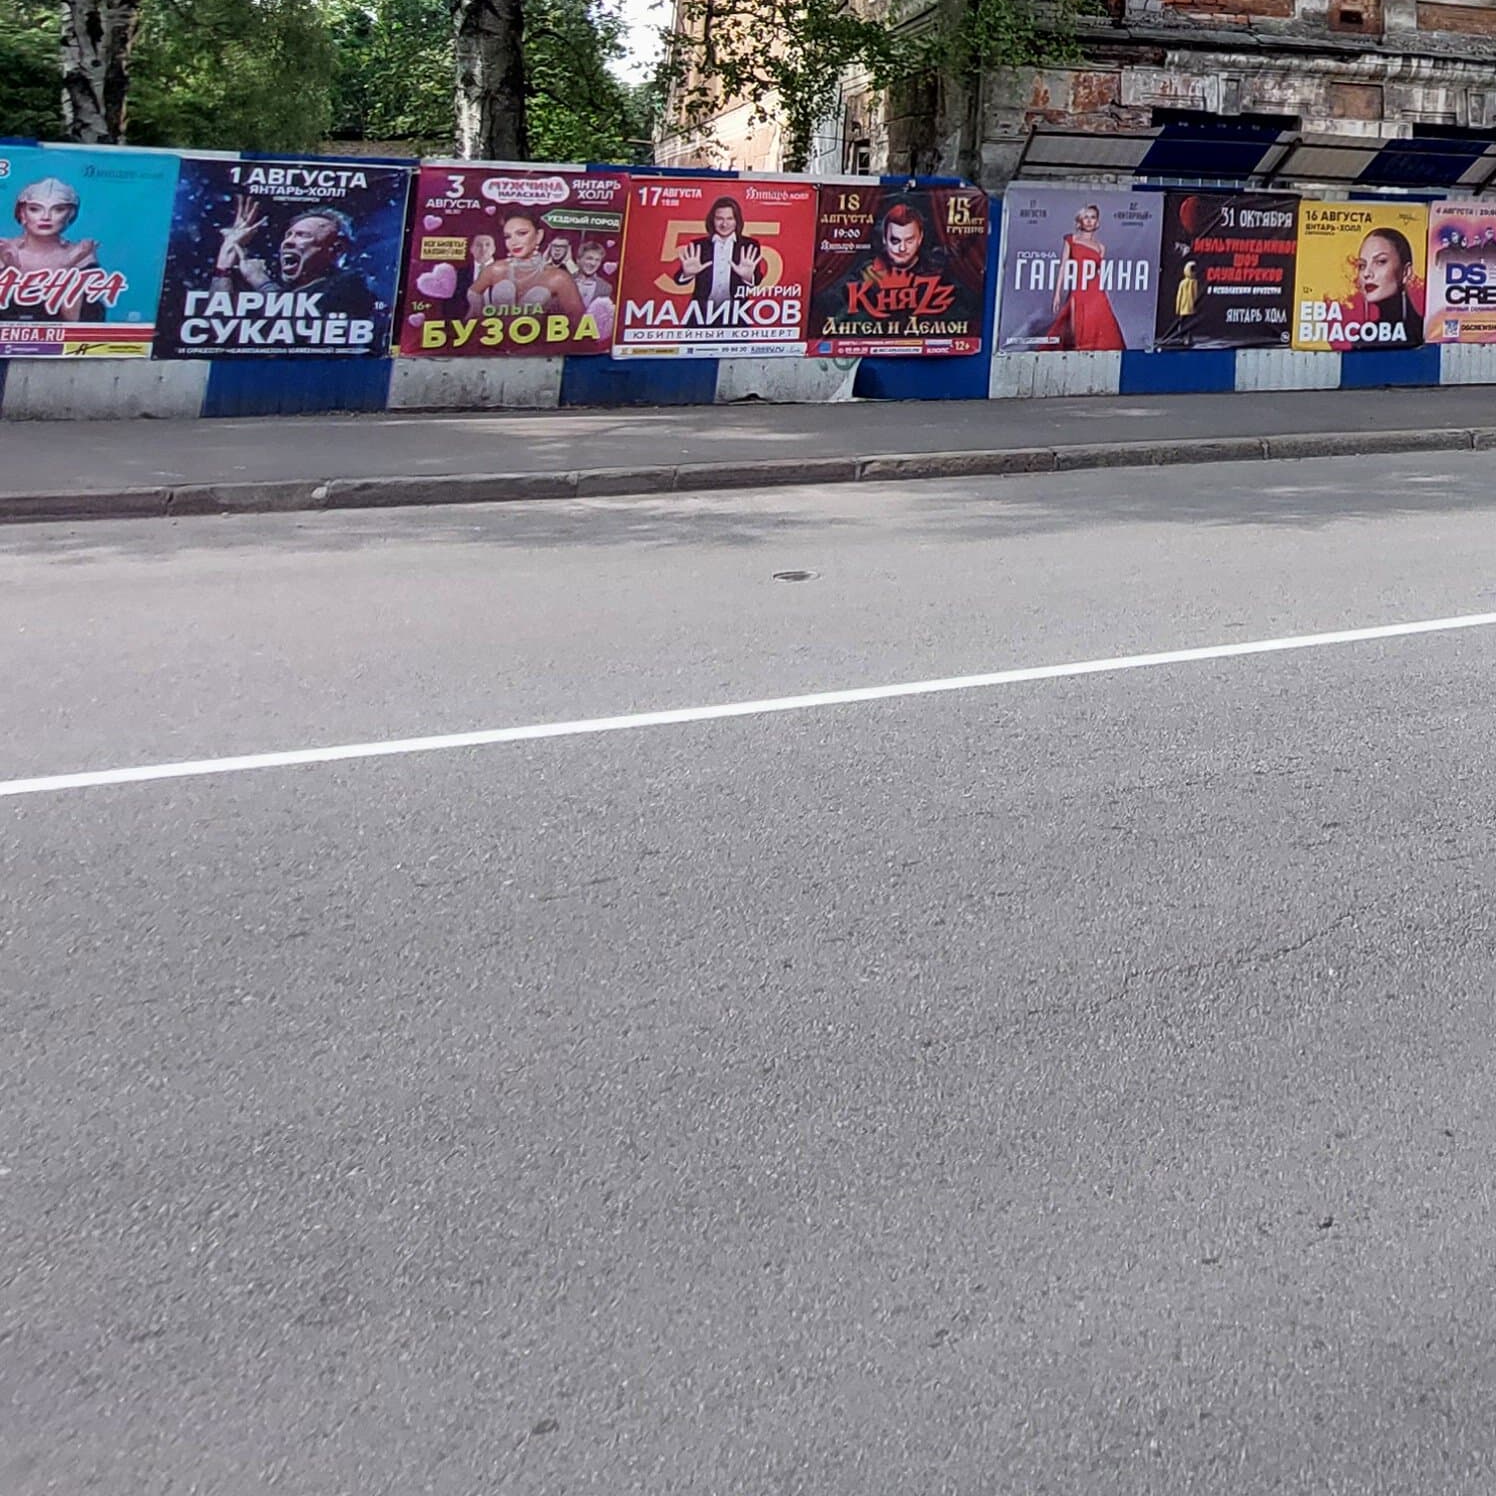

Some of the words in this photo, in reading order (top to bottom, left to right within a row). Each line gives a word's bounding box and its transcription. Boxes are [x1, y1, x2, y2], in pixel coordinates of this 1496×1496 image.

[230, 167, 241, 184] 1
[248, 168, 367, 188] АВГУСТА
[445, 175, 465, 198] 3
[572, 179, 621, 190] ЯНТАРЬ
[250, 185, 346, 197] ЯНТАРЬ-ХОЛЛ
[577, 190, 614, 200] ХОЛЛ
[638, 187, 663, 207] 17
[662, 187, 702, 199] АВГУСТА
[425, 198, 480, 209] АВГУСТА
[839, 194, 860, 211] 18
[947, 196, 971, 226] 15
[820, 213, 874, 226] АВГУСТА
[1220, 207, 1234, 227] 31
[1240, 210, 1293, 228] ОКТЯБРЯ
[1305, 210, 1318, 221] 16
[1321, 211, 1372, 223] АВГУСТА
[1015, 259, 1149, 291] ГАГАРИНА
[1446, 263, 1487, 285] DS
[734, 284, 801, 298] ДМИТРИЙ
[184, 291, 325, 317] ГАРИК
[483, 303, 544, 316] ОЛЬГА
[625, 299, 801, 326] МАЛИКОВ
[1301, 301, 1343, 321] ЕВА
[1225, 308, 1262, 323] ЯНТАРЬ
[1265, 308, 1287, 323] ХОЛЛ
[180, 312, 374, 344] СУКАЧЁВ
[422, 314, 600, 348] БУЗОВА
[633, 329, 724, 339] ЮБИЛЕЙНЫЙ
[732, 329, 792, 338] КОНЦЕРТ
[1299, 322, 1407, 342] ВЛАСОВА
